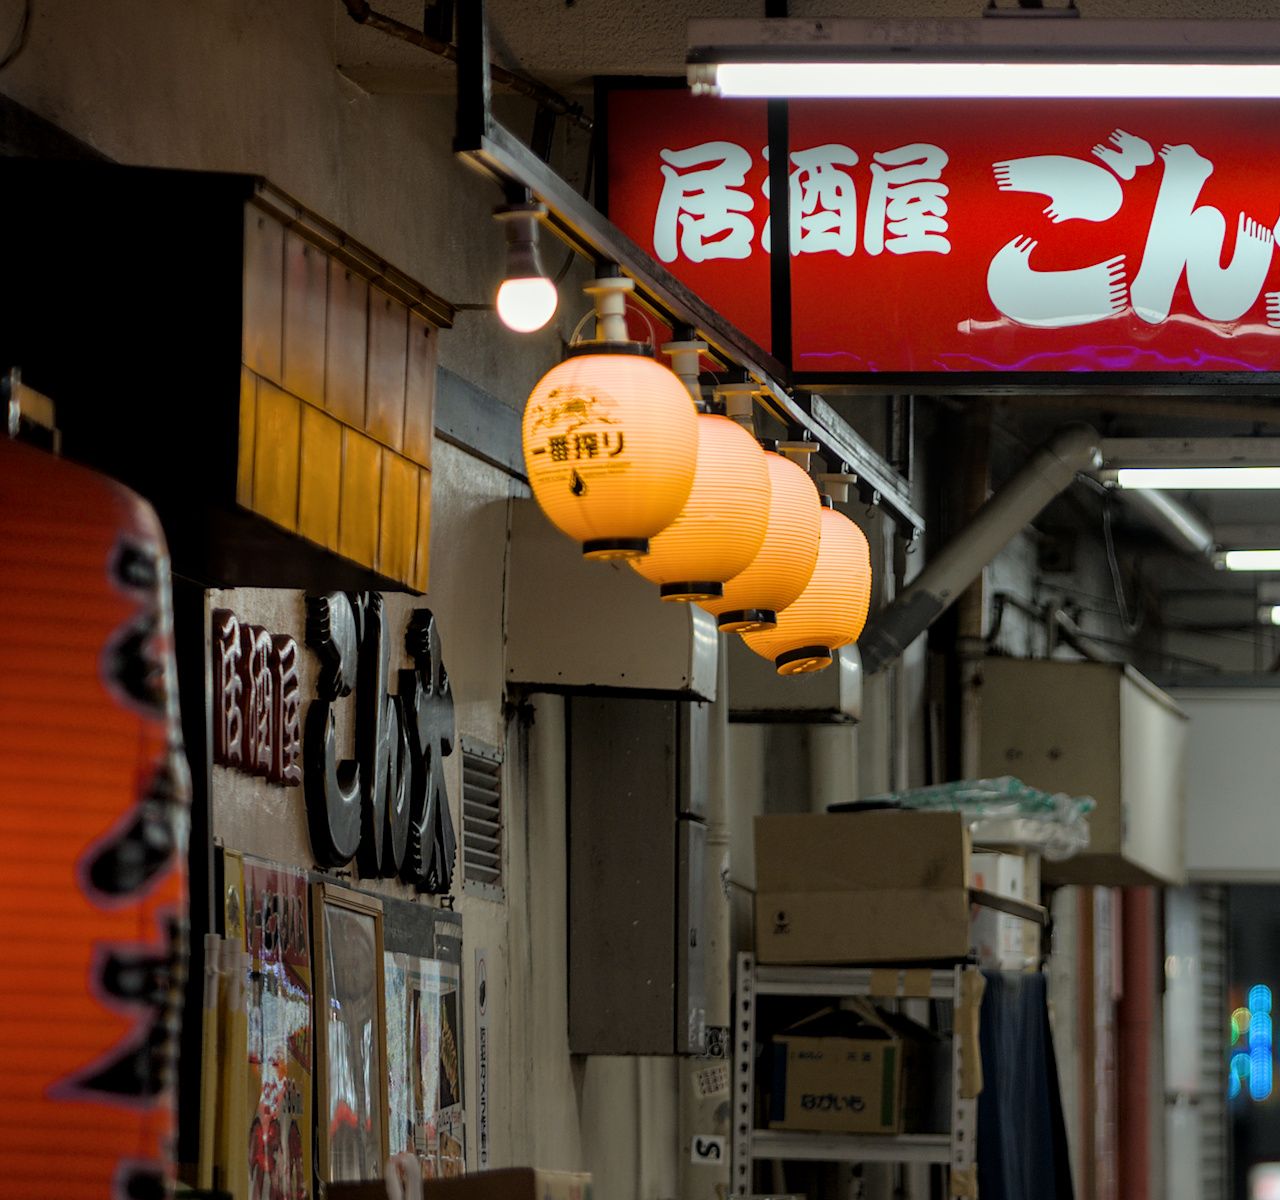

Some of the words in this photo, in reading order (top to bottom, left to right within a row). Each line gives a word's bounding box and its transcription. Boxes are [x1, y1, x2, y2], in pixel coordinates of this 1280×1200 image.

[653, 141, 952, 263] 居酒屋
[531, 430, 625, 462] 一番搾り
